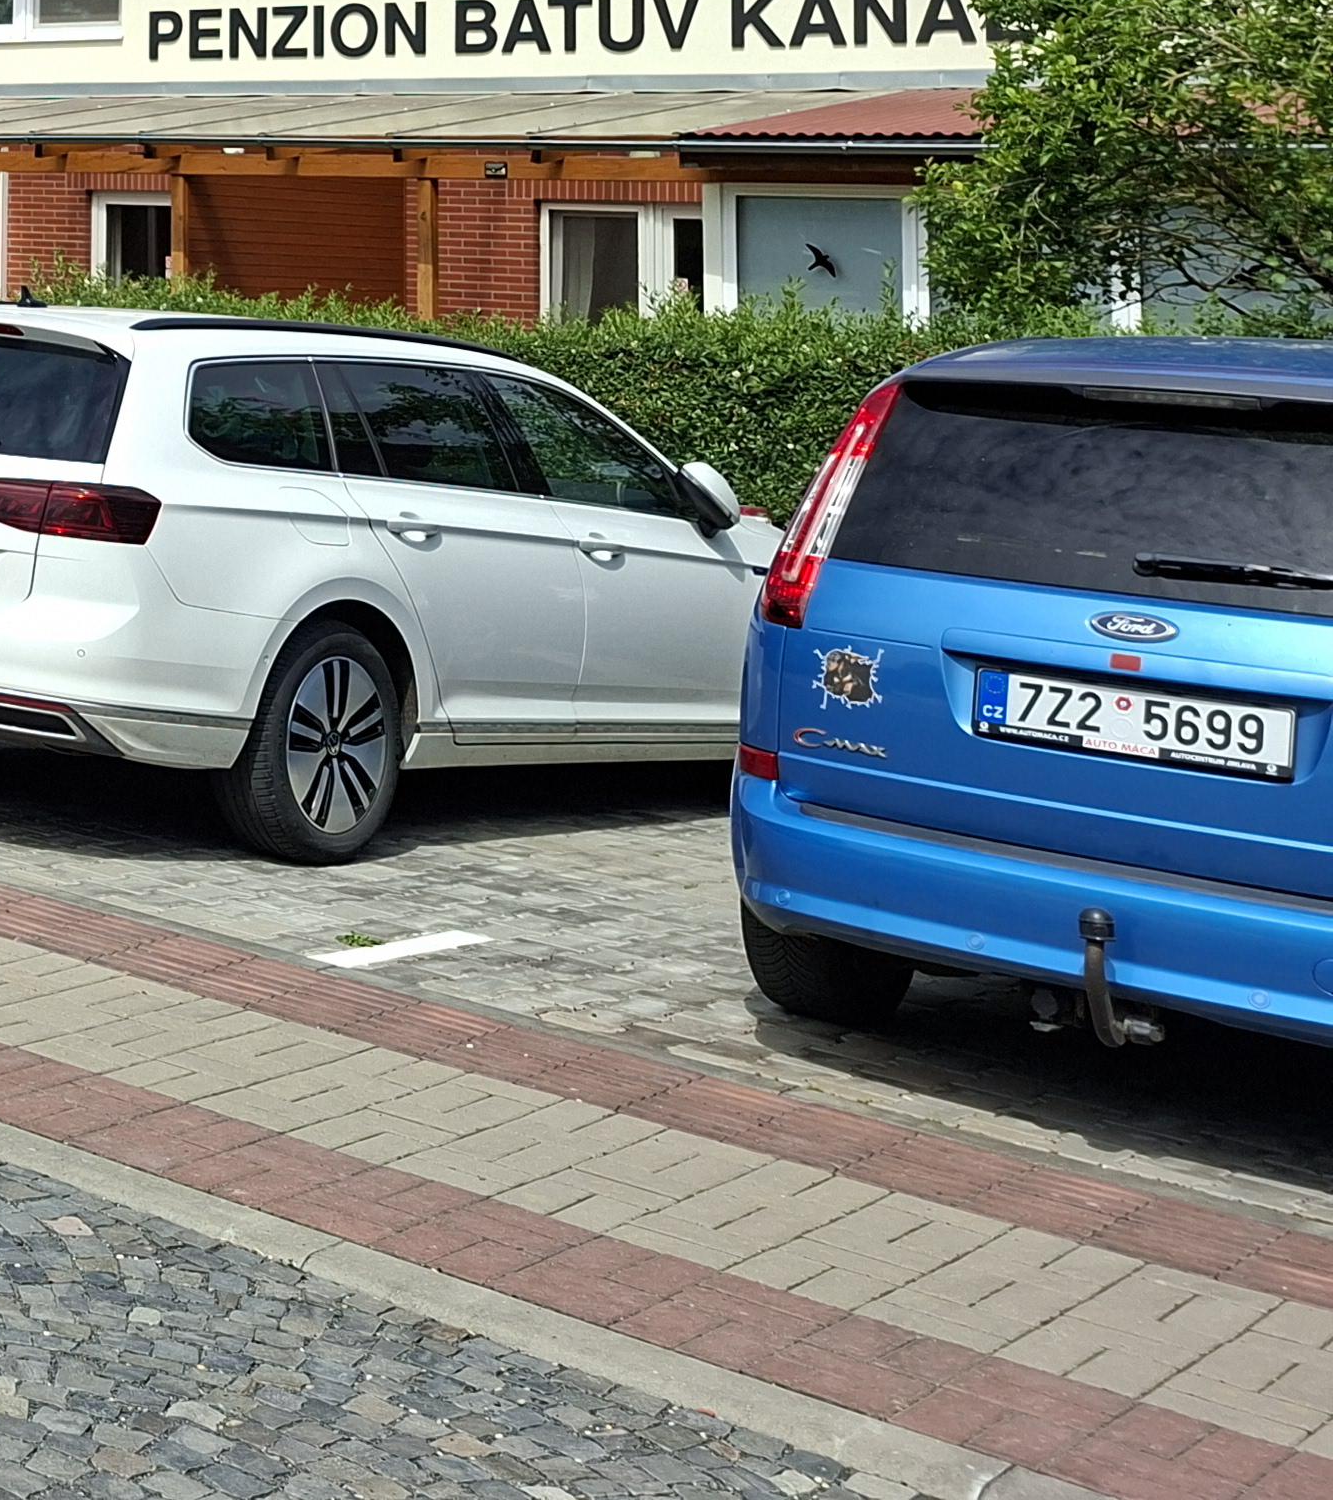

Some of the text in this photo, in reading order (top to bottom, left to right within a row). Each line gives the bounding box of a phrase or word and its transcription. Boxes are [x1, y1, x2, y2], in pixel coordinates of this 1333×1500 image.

[149, 3, 426, 60] PENZION
[1106, 615, 1157, 635] Ford
[983, 703, 1004, 719] CZ
[1018, 681, 1265, 755] 7Z2 5699
[1084, 737, 1117, 750] AUTO
